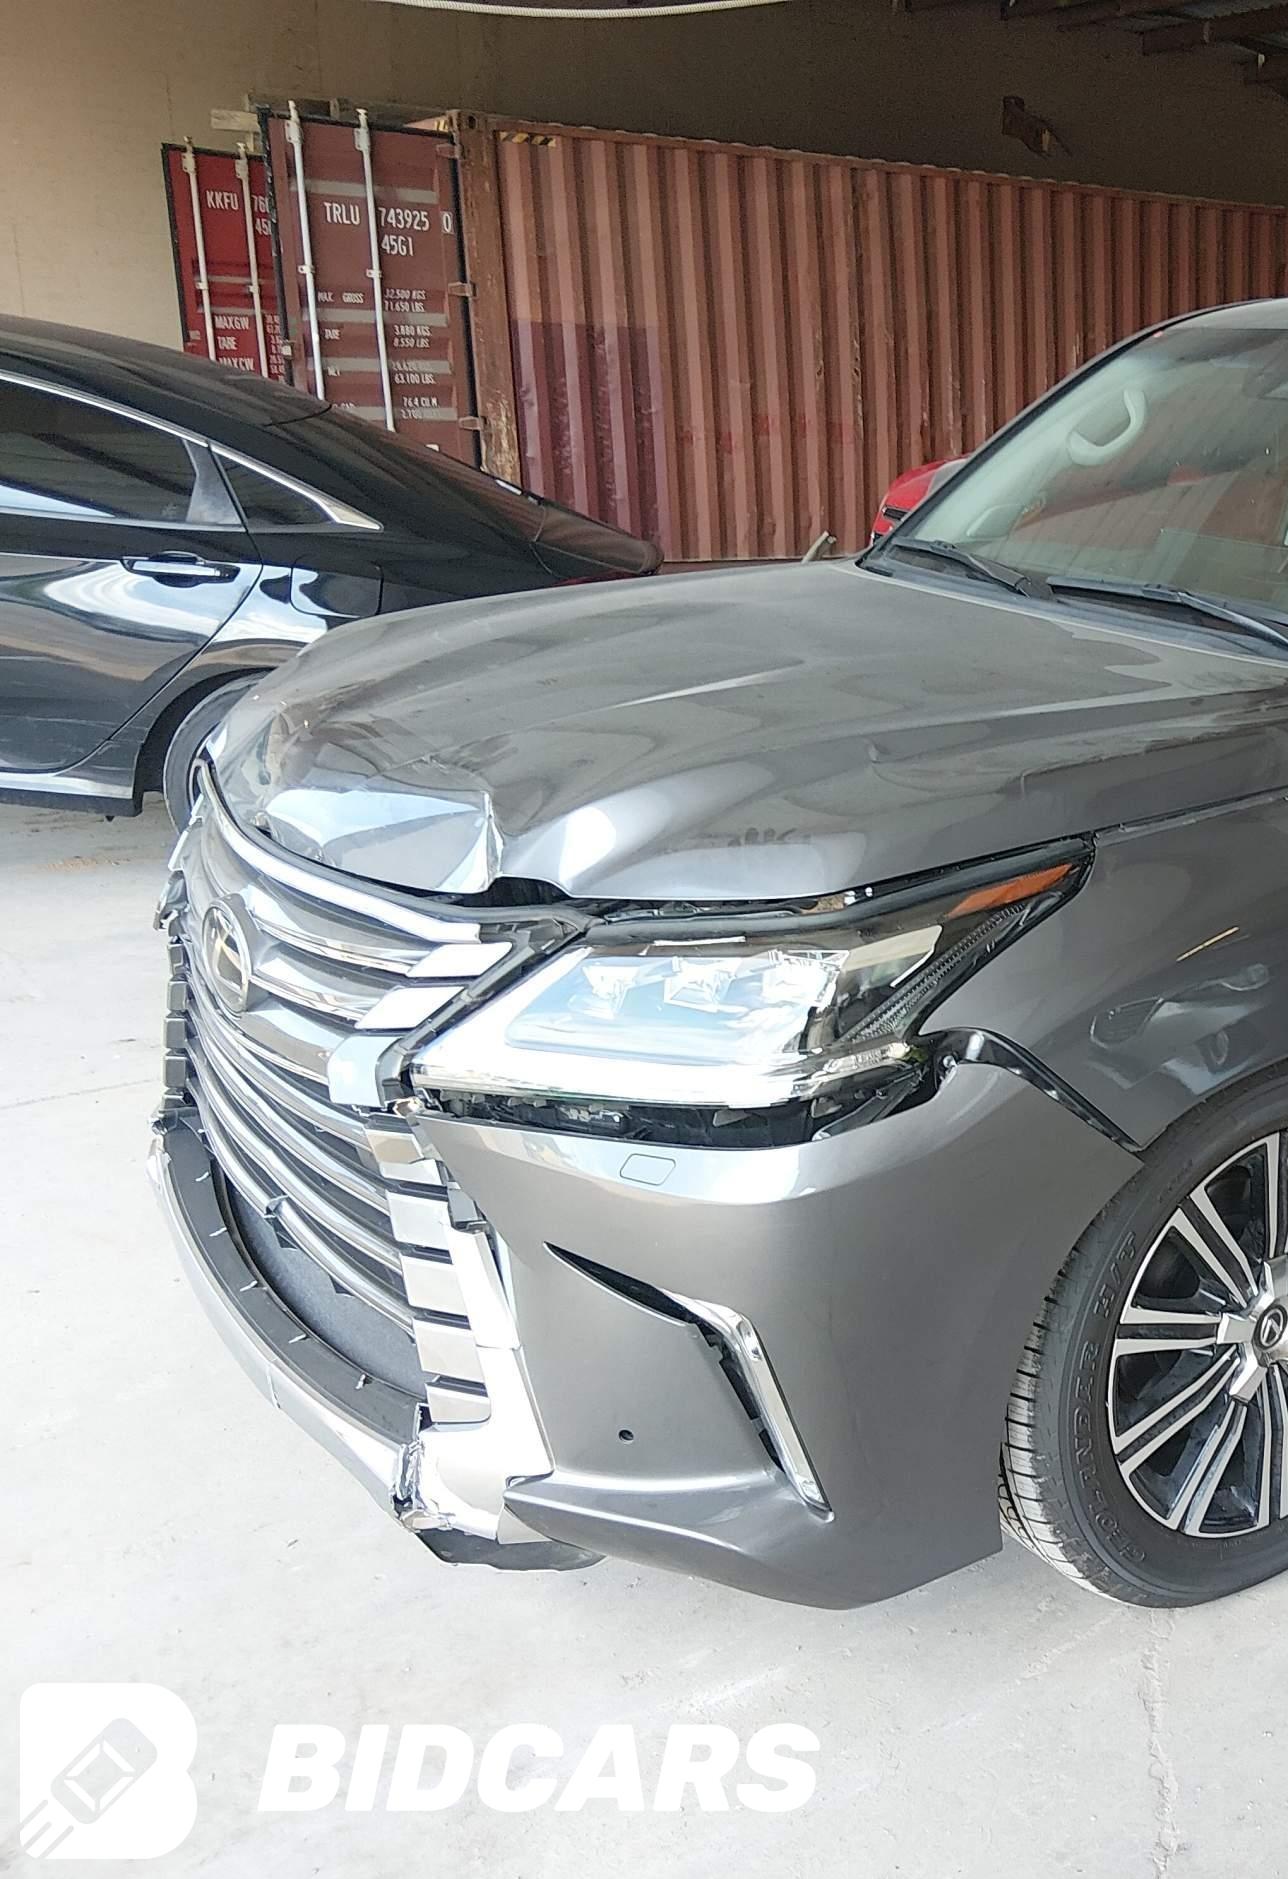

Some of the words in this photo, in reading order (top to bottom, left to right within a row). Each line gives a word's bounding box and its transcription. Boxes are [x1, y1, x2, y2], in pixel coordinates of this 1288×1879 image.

[206, 190, 239, 211] KKFU
[324, 202, 360, 225] TRLU
[378, 207, 430, 231] 743925
[381, 233, 414, 256] 45G1
[342, 292, 364, 304] GROSS
[324, 328, 341, 340] TARE
[217, 336, 238, 350] TARE
